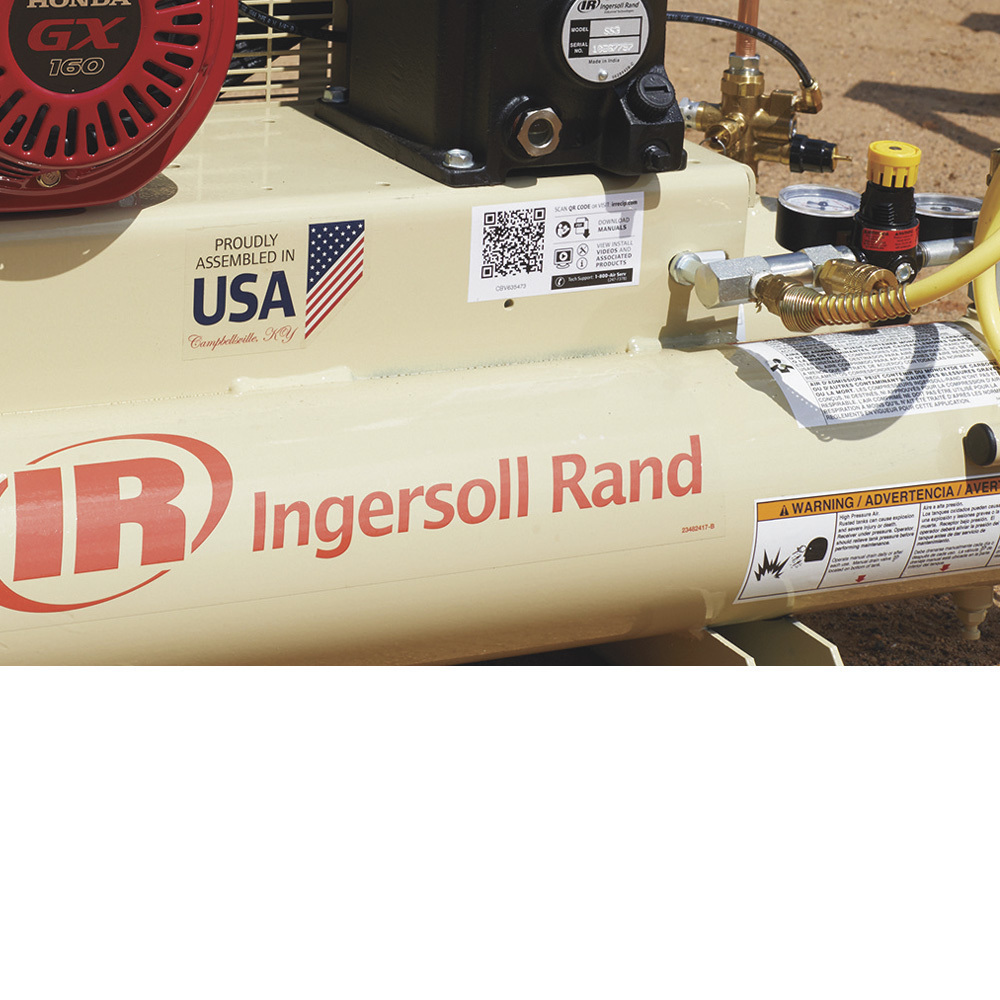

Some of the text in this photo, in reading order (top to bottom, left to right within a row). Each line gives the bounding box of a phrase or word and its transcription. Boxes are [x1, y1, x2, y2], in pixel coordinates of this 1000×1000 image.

[600, 2, 624, 10] Ingersoll
[27, 17, 127, 52] GX
[571, 26, 589, 34] MODEL
[49, 57, 104, 76] 160
[612, 200, 638, 208] irrecip.com
[215, 234, 278, 250] PROUDLY
[196, 250, 294, 270] ASSEMBLED IN
[596, 253, 632, 261] ASSOCIATED
[596, 260, 626, 268] PRODUCTS
[193, 270, 296, 326] USA
[262, 326, 298, 343] KY
[252, 456, 528, 559] Ingersoll
[552, 434, 702, 513] Rand
[792, 496, 854, 514] WARNING
[865, 486, 954, 507] ADVERTENCIA
[893, 513, 914, 521] explosion
